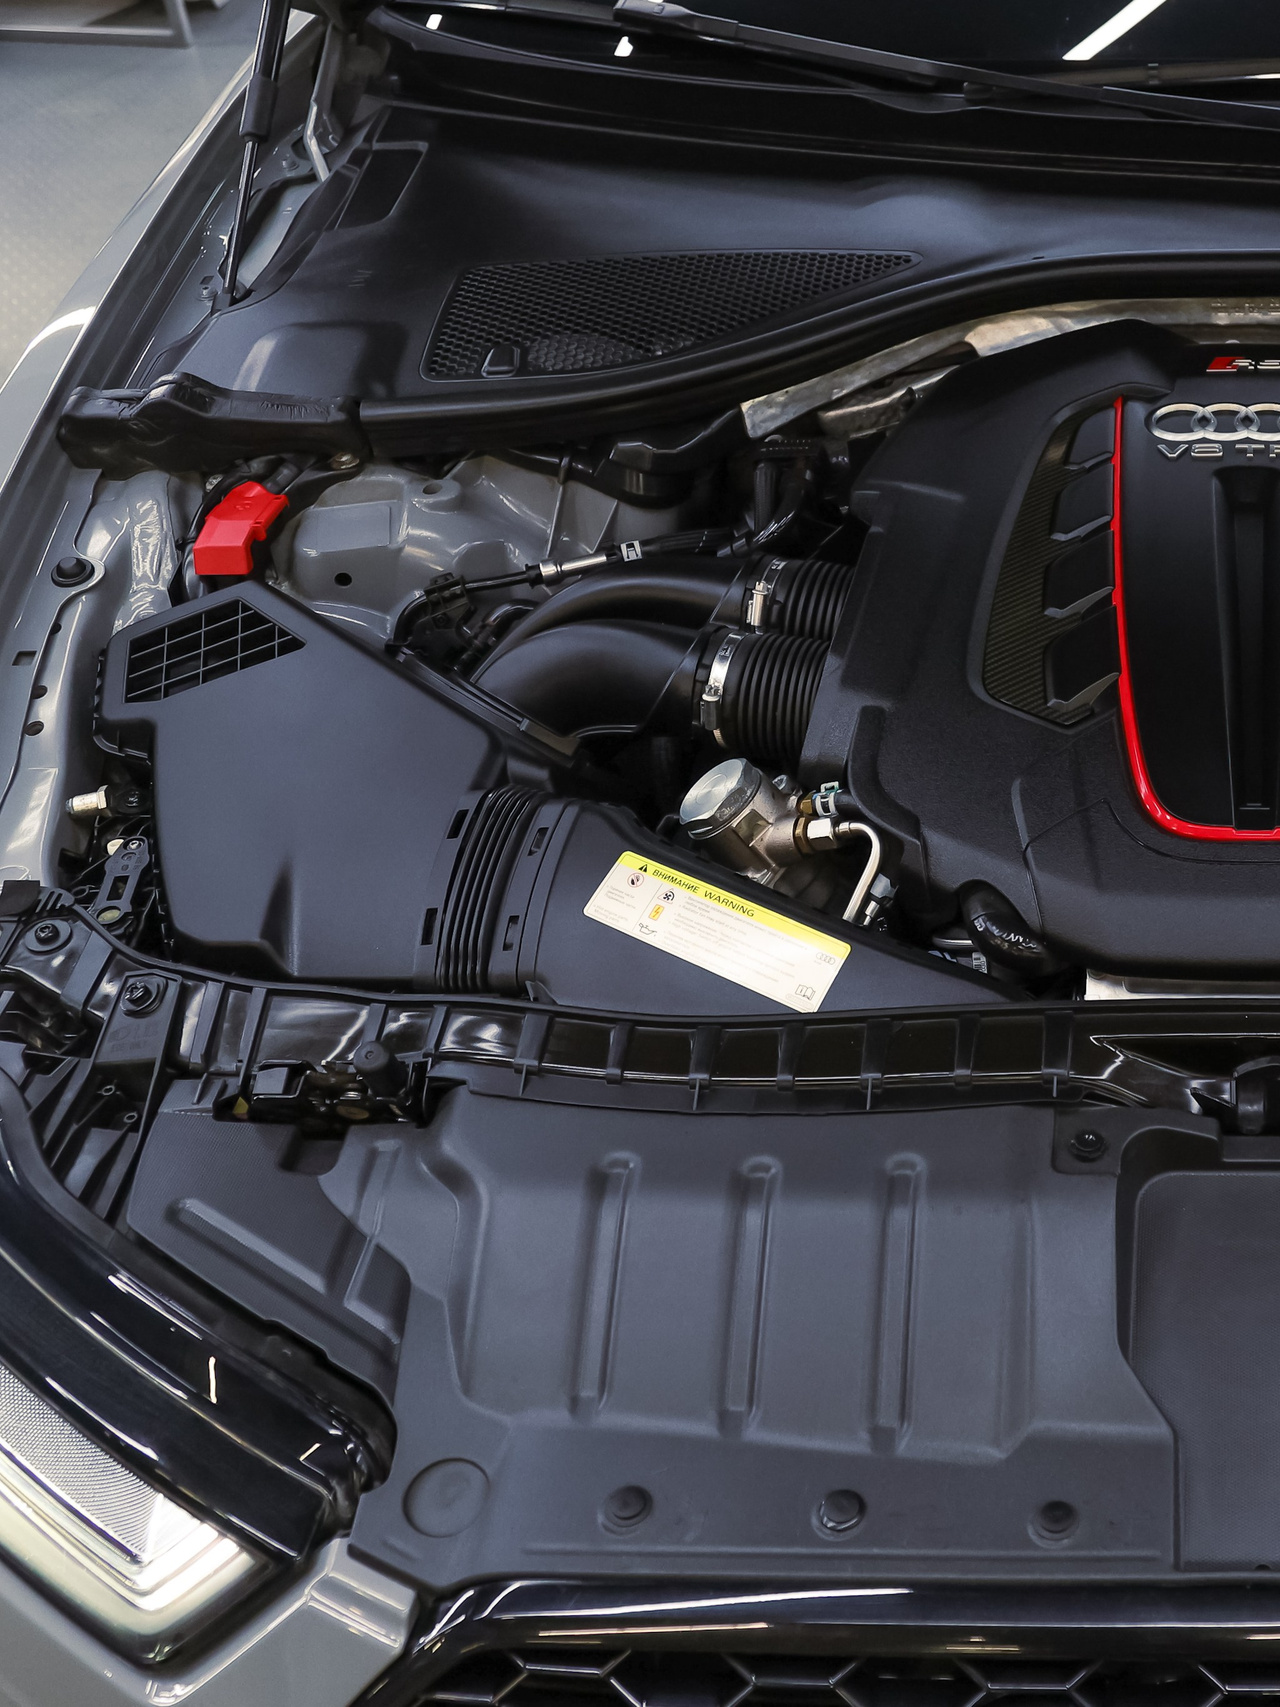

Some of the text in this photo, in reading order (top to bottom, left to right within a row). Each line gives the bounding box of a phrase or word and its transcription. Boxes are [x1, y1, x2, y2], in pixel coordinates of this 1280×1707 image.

[1157, 443, 1224, 459] V8
[652, 868, 699, 894] ВНИМАНИЕ
[704, 890, 755, 917] WARNING
